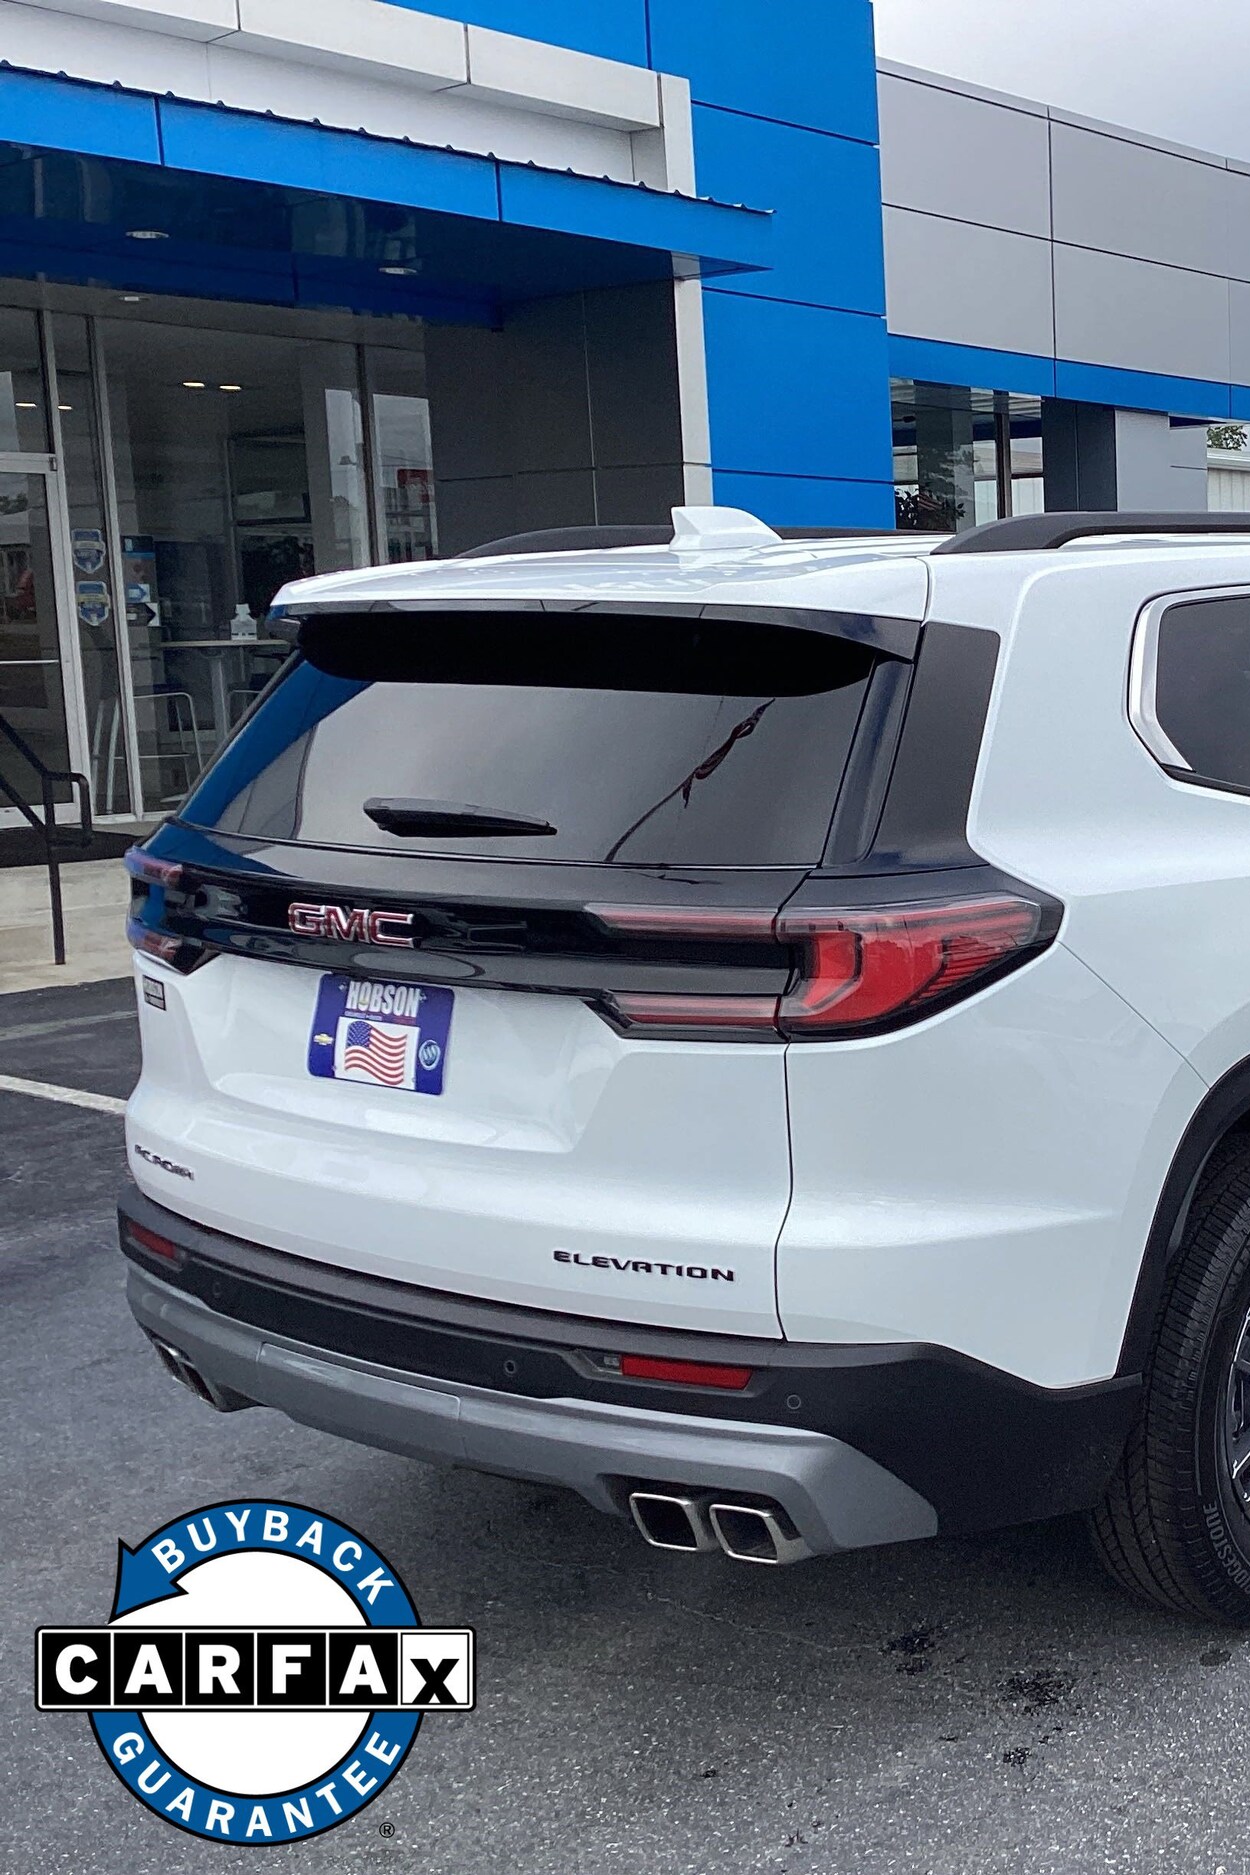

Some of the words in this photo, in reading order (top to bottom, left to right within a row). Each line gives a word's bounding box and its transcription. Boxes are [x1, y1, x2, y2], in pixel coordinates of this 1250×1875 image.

[288, 902, 414, 948] GMC
[346, 981, 422, 1018] HOBSON
[553, 1250, 735, 1282] ELEVATION
